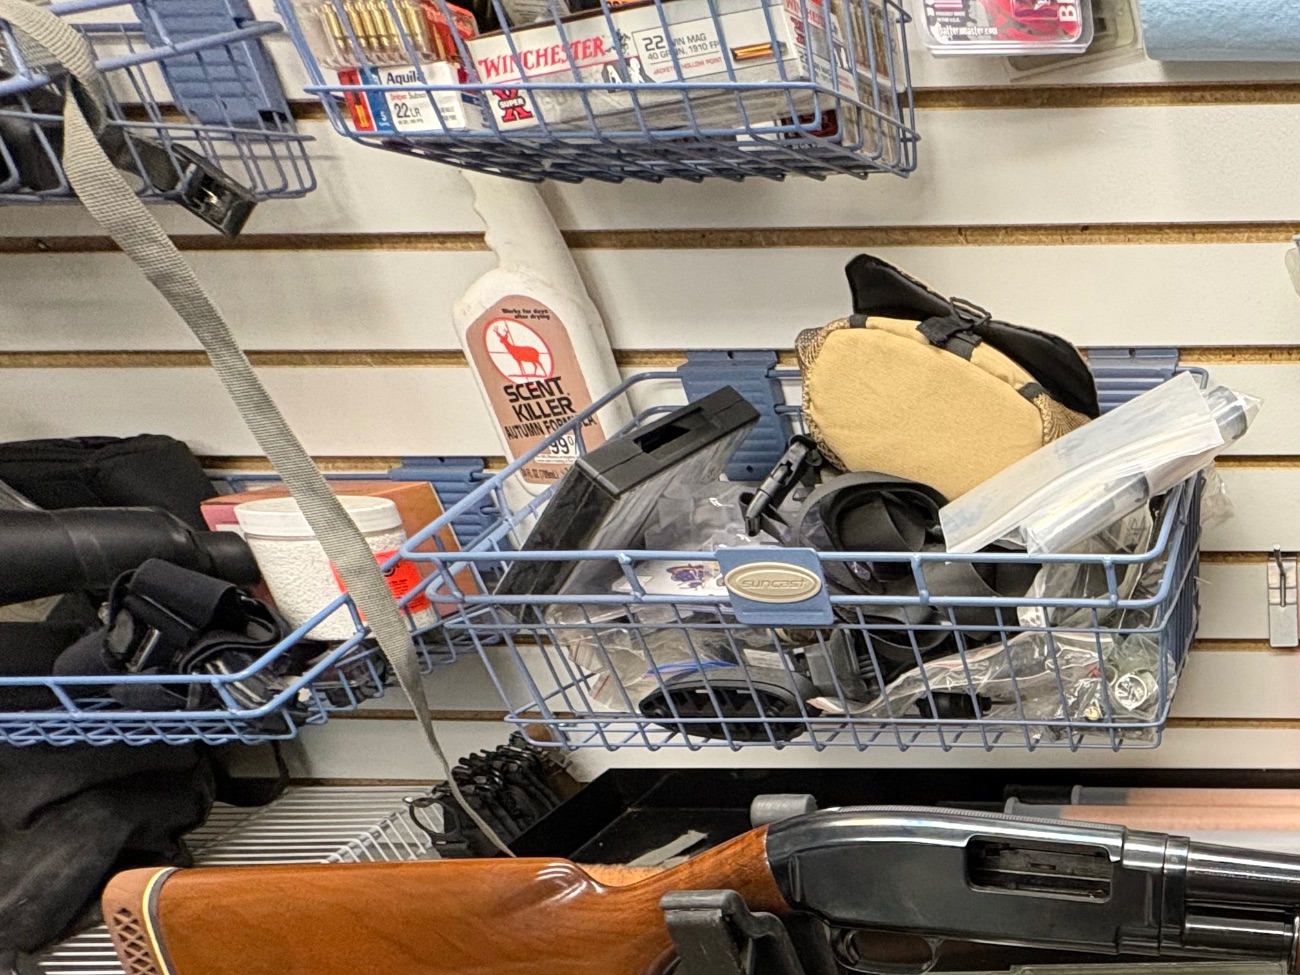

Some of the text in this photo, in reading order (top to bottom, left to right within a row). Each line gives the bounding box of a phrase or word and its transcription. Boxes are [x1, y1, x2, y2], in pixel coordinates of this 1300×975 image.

[642, 35, 666, 51] 22
[686, 33, 707, 44] MAG
[478, 35, 607, 79] WINCHESTER
[648, 52, 659, 60] 40
[689, 43, 708, 53] 1910
[394, 102, 421, 119] 22 LR
[500, 98, 524, 110] SUPER
[503, 376, 566, 404] SCENT
[511, 396, 578, 422] KILLER
[504, 421, 544, 440] AUTUMN
